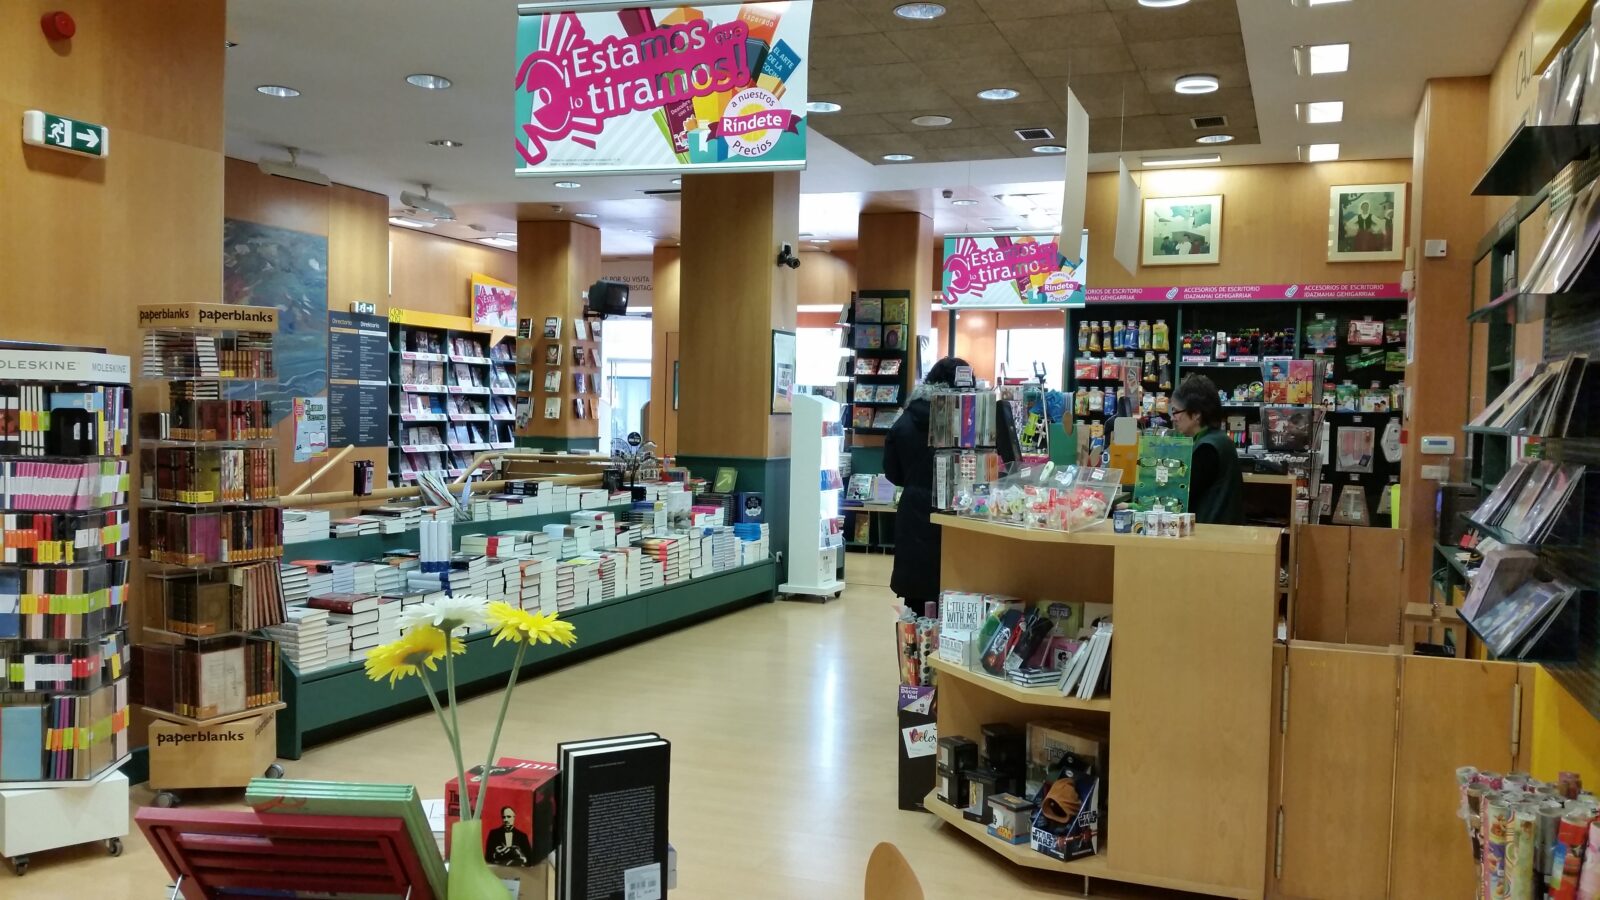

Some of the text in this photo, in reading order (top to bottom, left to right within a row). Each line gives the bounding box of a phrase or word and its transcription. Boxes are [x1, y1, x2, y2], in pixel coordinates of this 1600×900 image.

[562, 26, 706, 88] ¡Estamos
[779, 53, 795, 70] ARTE
[570, 44, 744, 114] lo tiramos!
[731, 89, 775, 108] a nuestros
[723, 113, 782, 133] Ríndete
[732, 138, 772, 155] Precios
[139, 309, 189, 325] paperblanks
[199, 308, 273, 330] paperblanks
[91, 362, 127, 374] MOLESKINE
[967, 602, 978, 612] EYE
[946, 612, 978, 624] WITH ME!
[156, 731, 245, 746] paperblanks
[1032, 829, 1053, 841] STAR
[1032, 835, 1052, 846] WARS
